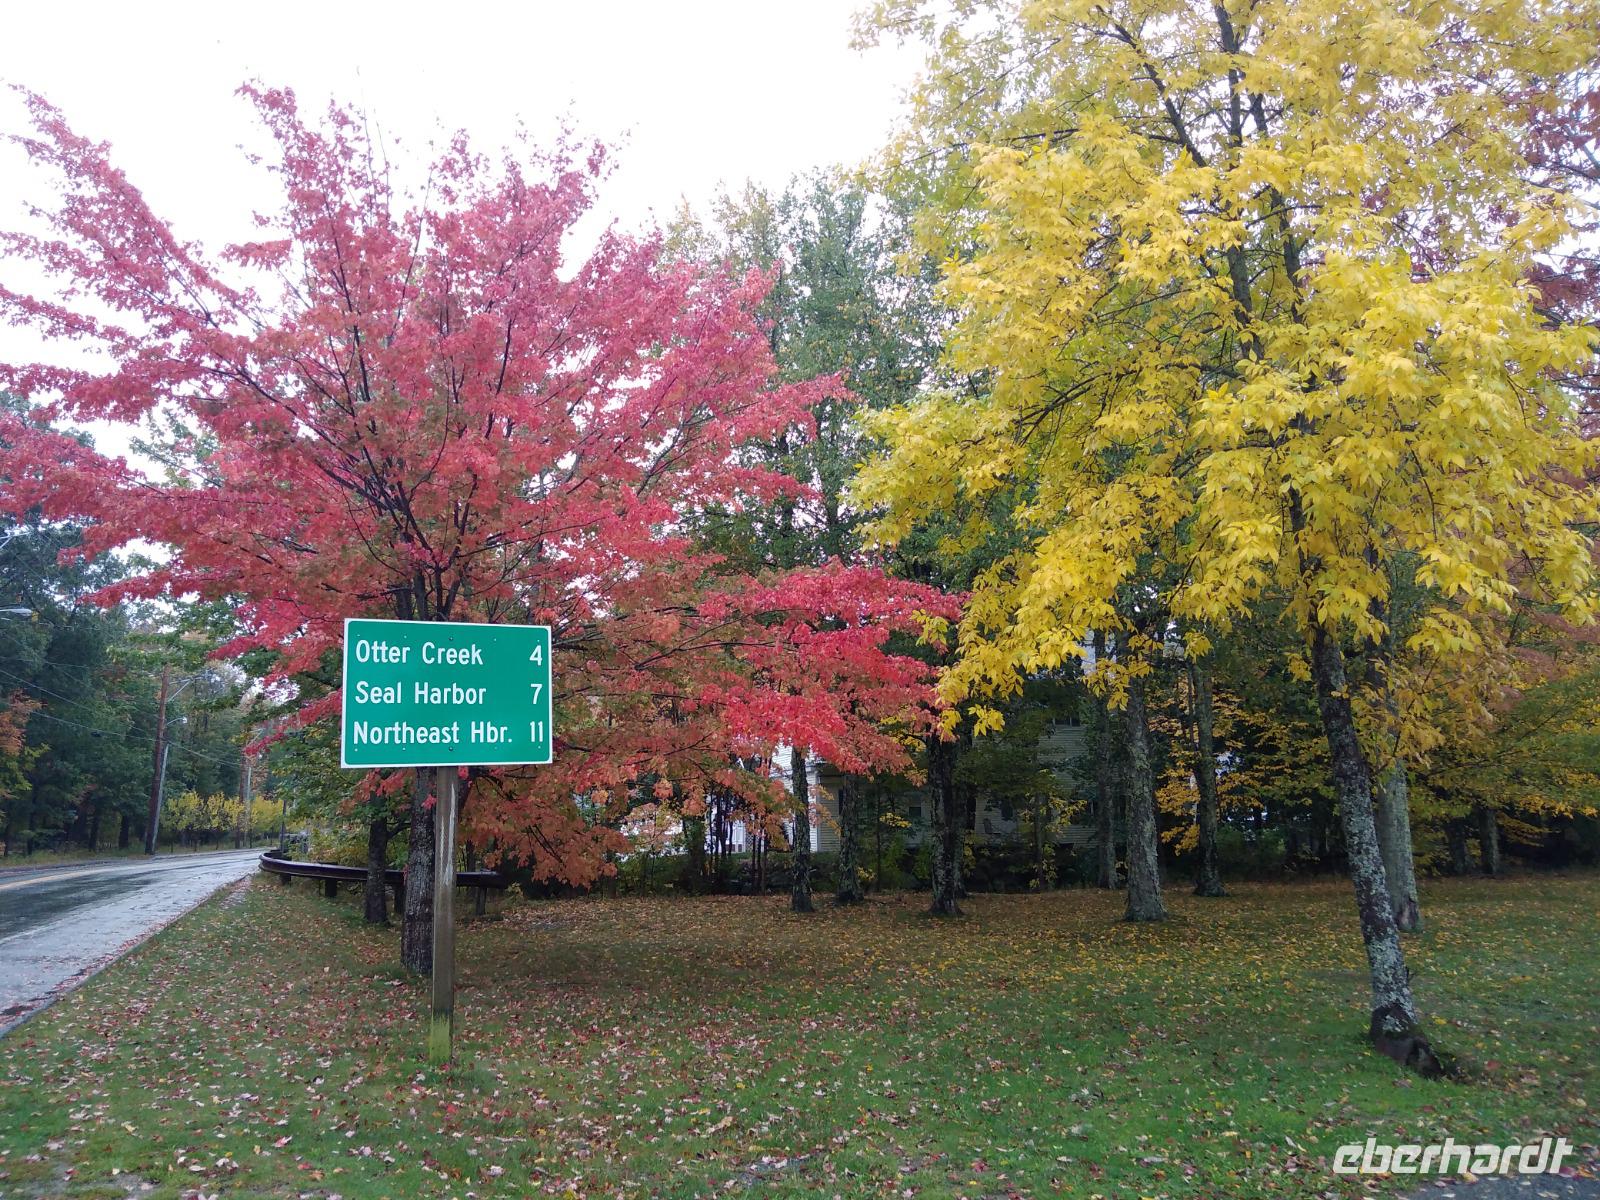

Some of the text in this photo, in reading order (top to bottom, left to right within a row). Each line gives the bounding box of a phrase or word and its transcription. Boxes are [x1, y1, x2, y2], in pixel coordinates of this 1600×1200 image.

[355, 639, 543, 666] Otter Creek 4
[355, 680, 543, 705] Seal Harbor 7
[353, 721, 544, 745] Northeast Hbr. 11
